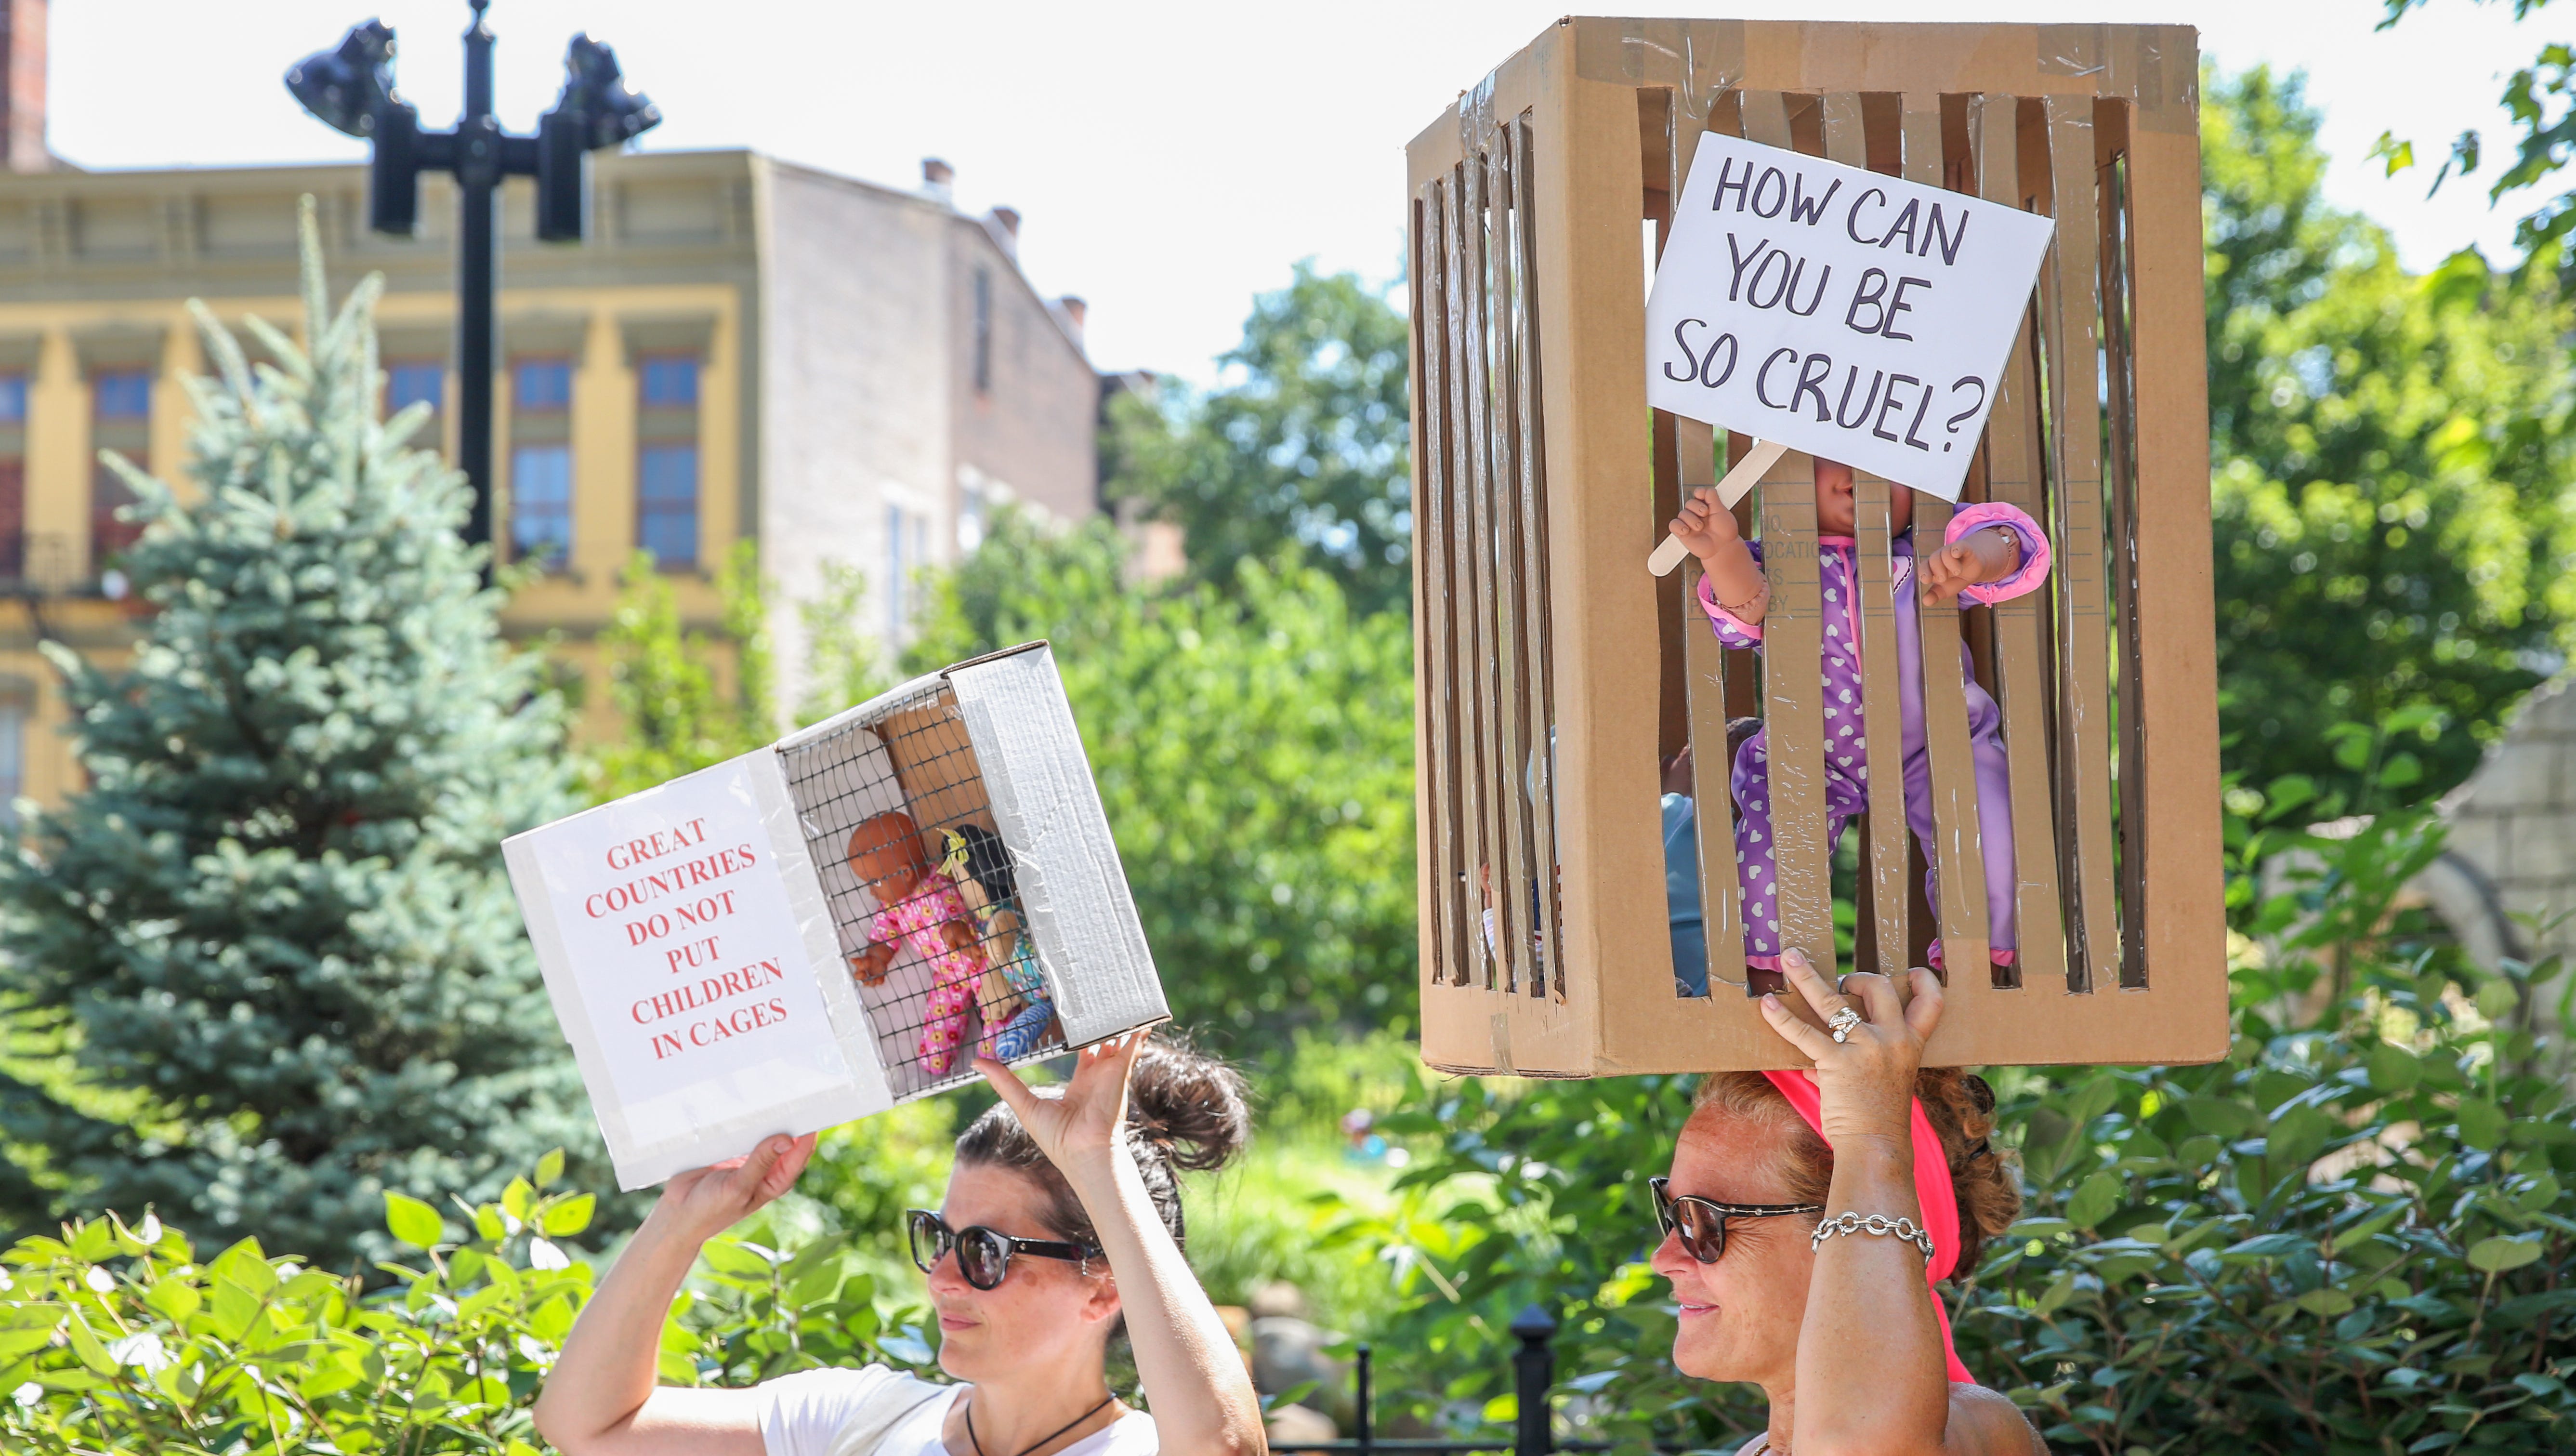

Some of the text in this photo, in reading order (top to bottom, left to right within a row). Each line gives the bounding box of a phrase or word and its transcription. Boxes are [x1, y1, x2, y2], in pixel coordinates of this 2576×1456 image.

[1712, 158, 1969, 265] HOW CAN
[1727, 233, 1932, 342] YOU BE
[1665, 319, 1985, 452] SO CRUEL?
[1765, 541, 1818, 558] OCATIO
[606, 818, 707, 871] GREAT
[585, 844, 756, 918] COUNTRIES
[625, 890, 735, 946] DO NOT
[665, 936, 720, 974] PUT
[631, 957, 784, 1025] CHILDREN
[651, 997, 787, 1060] IN CAGES
